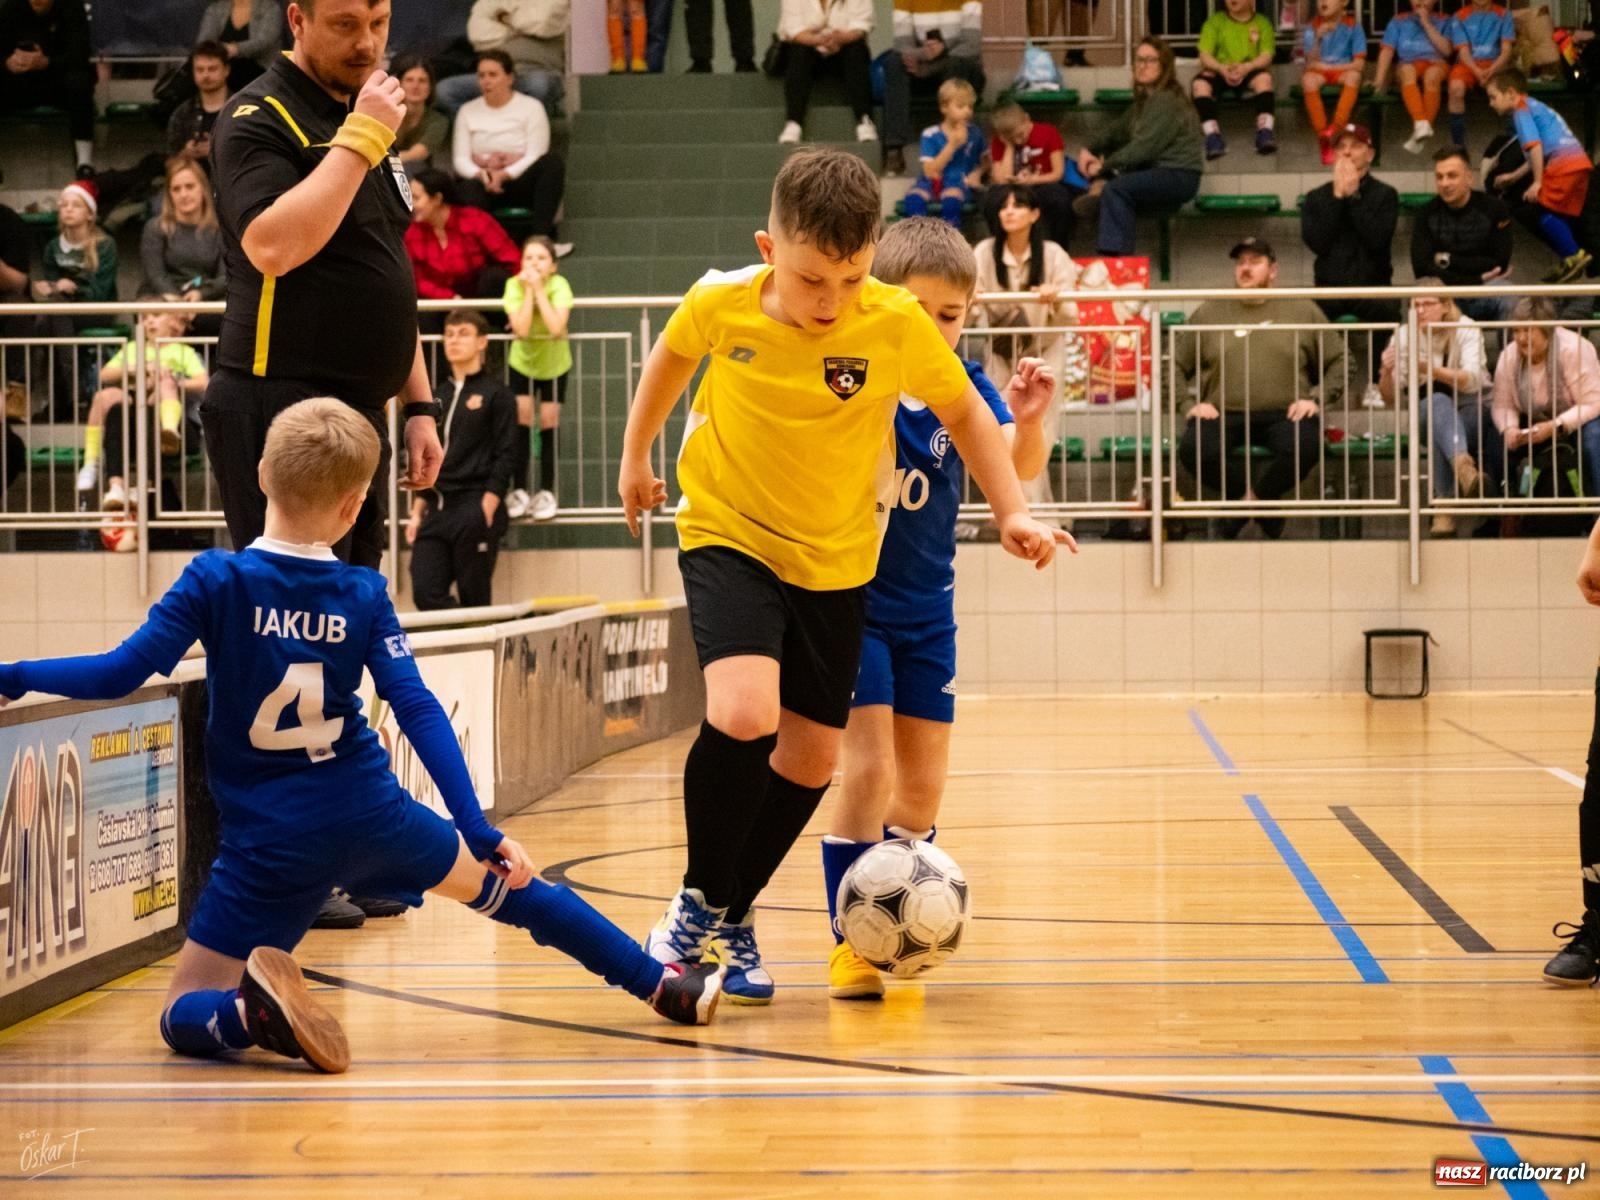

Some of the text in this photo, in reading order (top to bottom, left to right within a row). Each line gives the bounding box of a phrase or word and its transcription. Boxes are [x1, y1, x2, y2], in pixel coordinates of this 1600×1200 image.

[891, 468, 930, 511] 10
[254, 606, 347, 644] JAKUB
[249, 662, 345, 763] 4
[112, 854, 127, 887] 707
